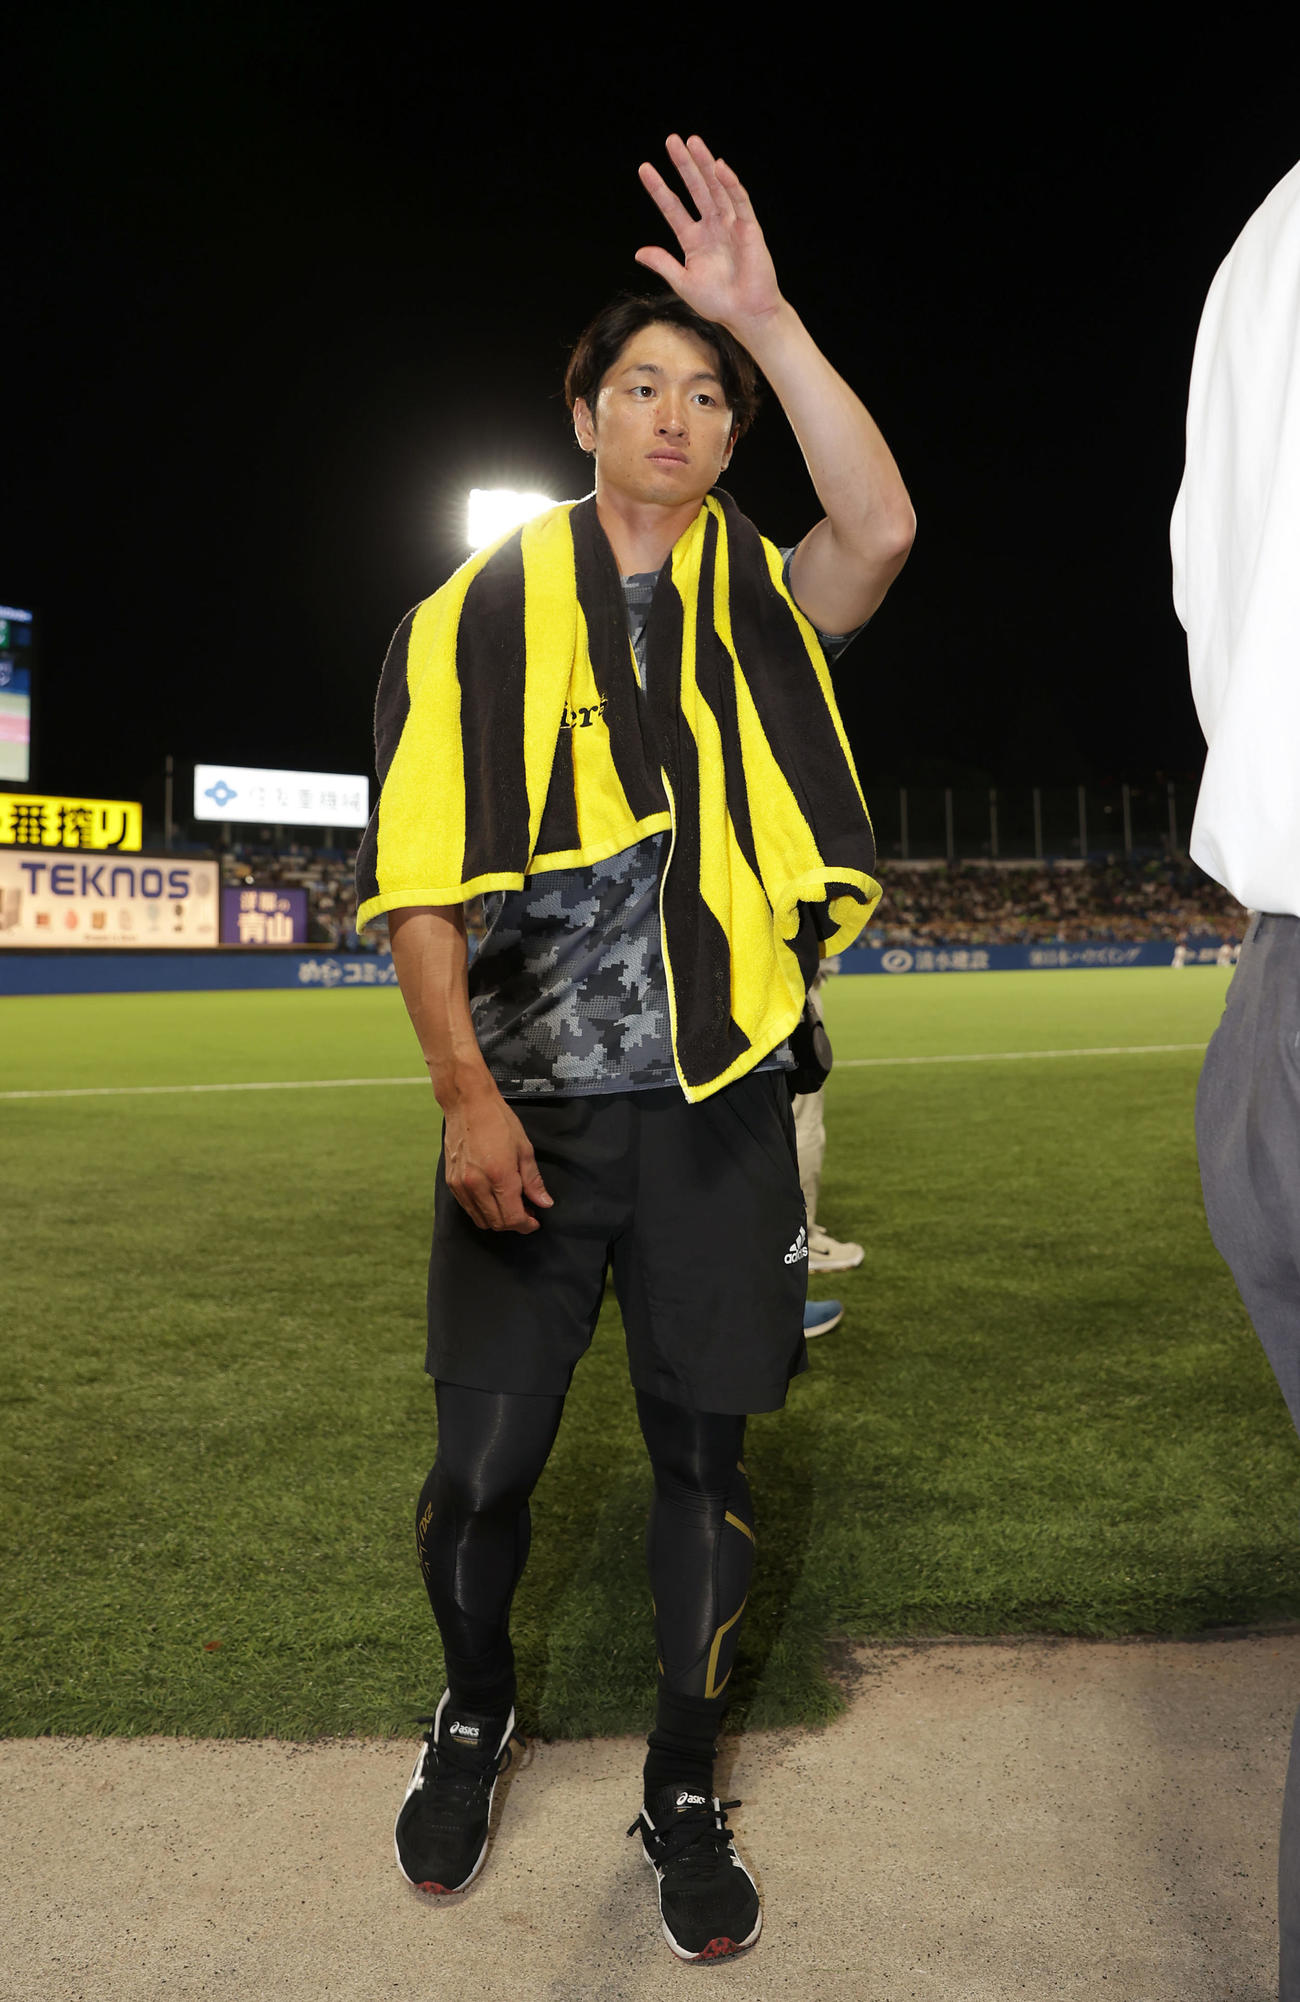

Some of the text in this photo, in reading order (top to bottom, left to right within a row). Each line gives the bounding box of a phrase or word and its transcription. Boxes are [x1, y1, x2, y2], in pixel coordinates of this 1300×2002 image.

[0, 804, 127, 846] 番搾り
[20, 861, 191, 899] TEKNOS
[237, 910, 294, 944] 青山
